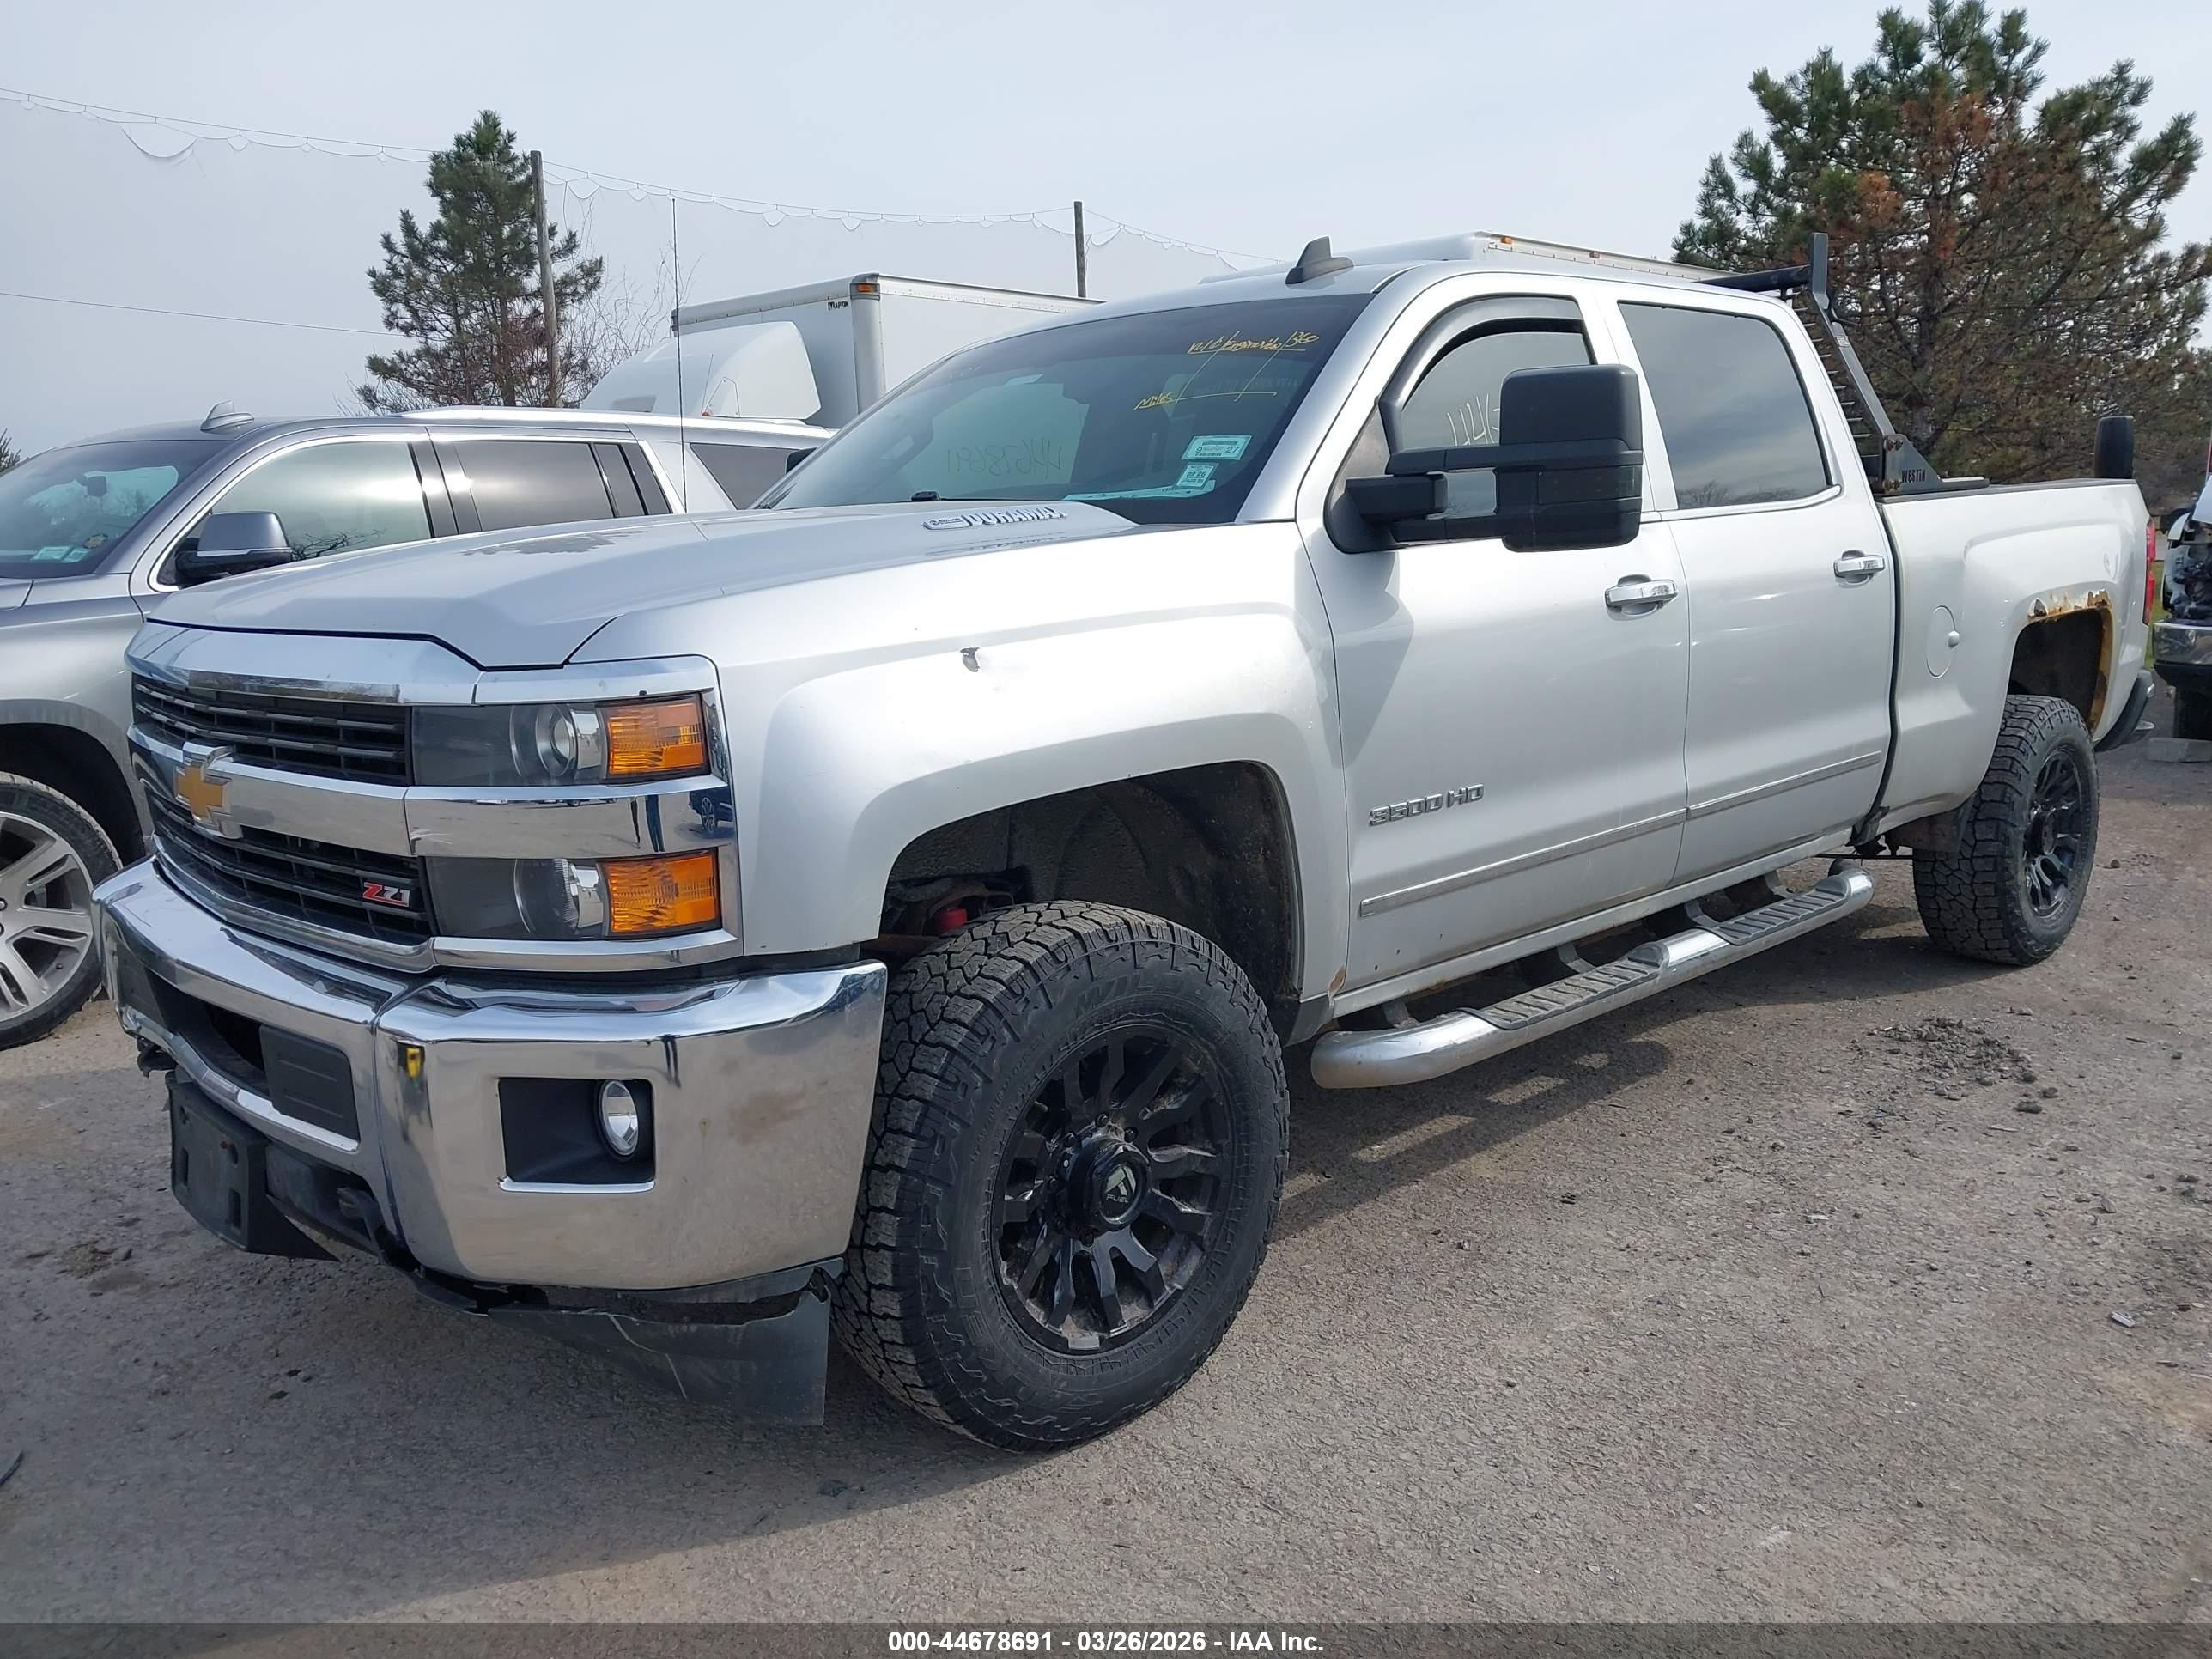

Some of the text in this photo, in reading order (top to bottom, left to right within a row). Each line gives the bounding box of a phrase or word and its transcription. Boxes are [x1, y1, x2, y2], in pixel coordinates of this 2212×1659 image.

[961, 507, 1068, 527] DURAMAX
[1446, 783, 1485, 808] HD
[362, 881, 411, 908] Z71
[1105, 1194, 1129, 1203] FUEL
